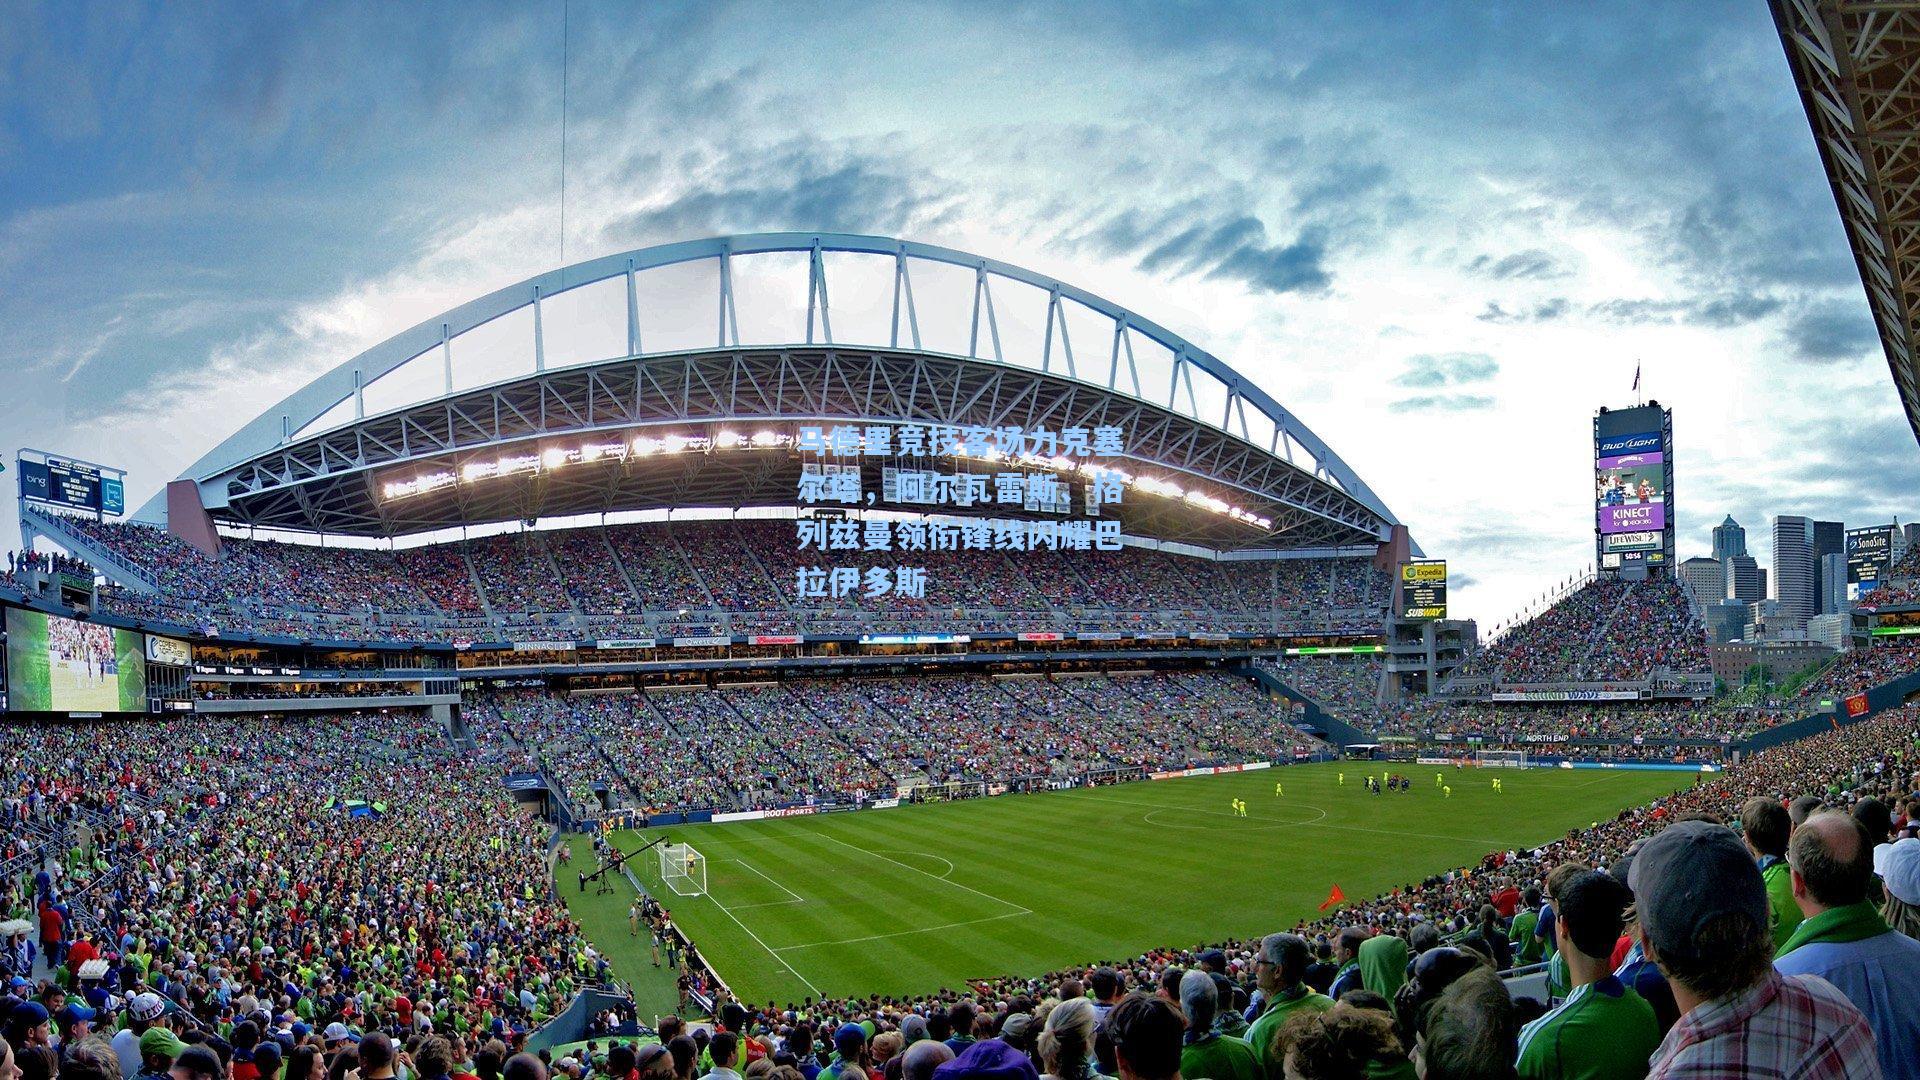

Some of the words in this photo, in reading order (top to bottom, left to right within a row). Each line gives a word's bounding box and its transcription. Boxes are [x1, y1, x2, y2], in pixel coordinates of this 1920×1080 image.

[1627, 438, 1658, 448] LIGHT
[26, 474, 46, 488] bing
[1613, 507, 1652, 519] KINECT
[1858, 536, 1886, 548] SonoSite
[1405, 607, 1445, 617] SUBWAY
[519, 641, 566, 650] PINNACLE
[685, 637, 710, 646] Qwest
[764, 809, 786, 818] ROOT
[786, 807, 813, 816] SPORTS
